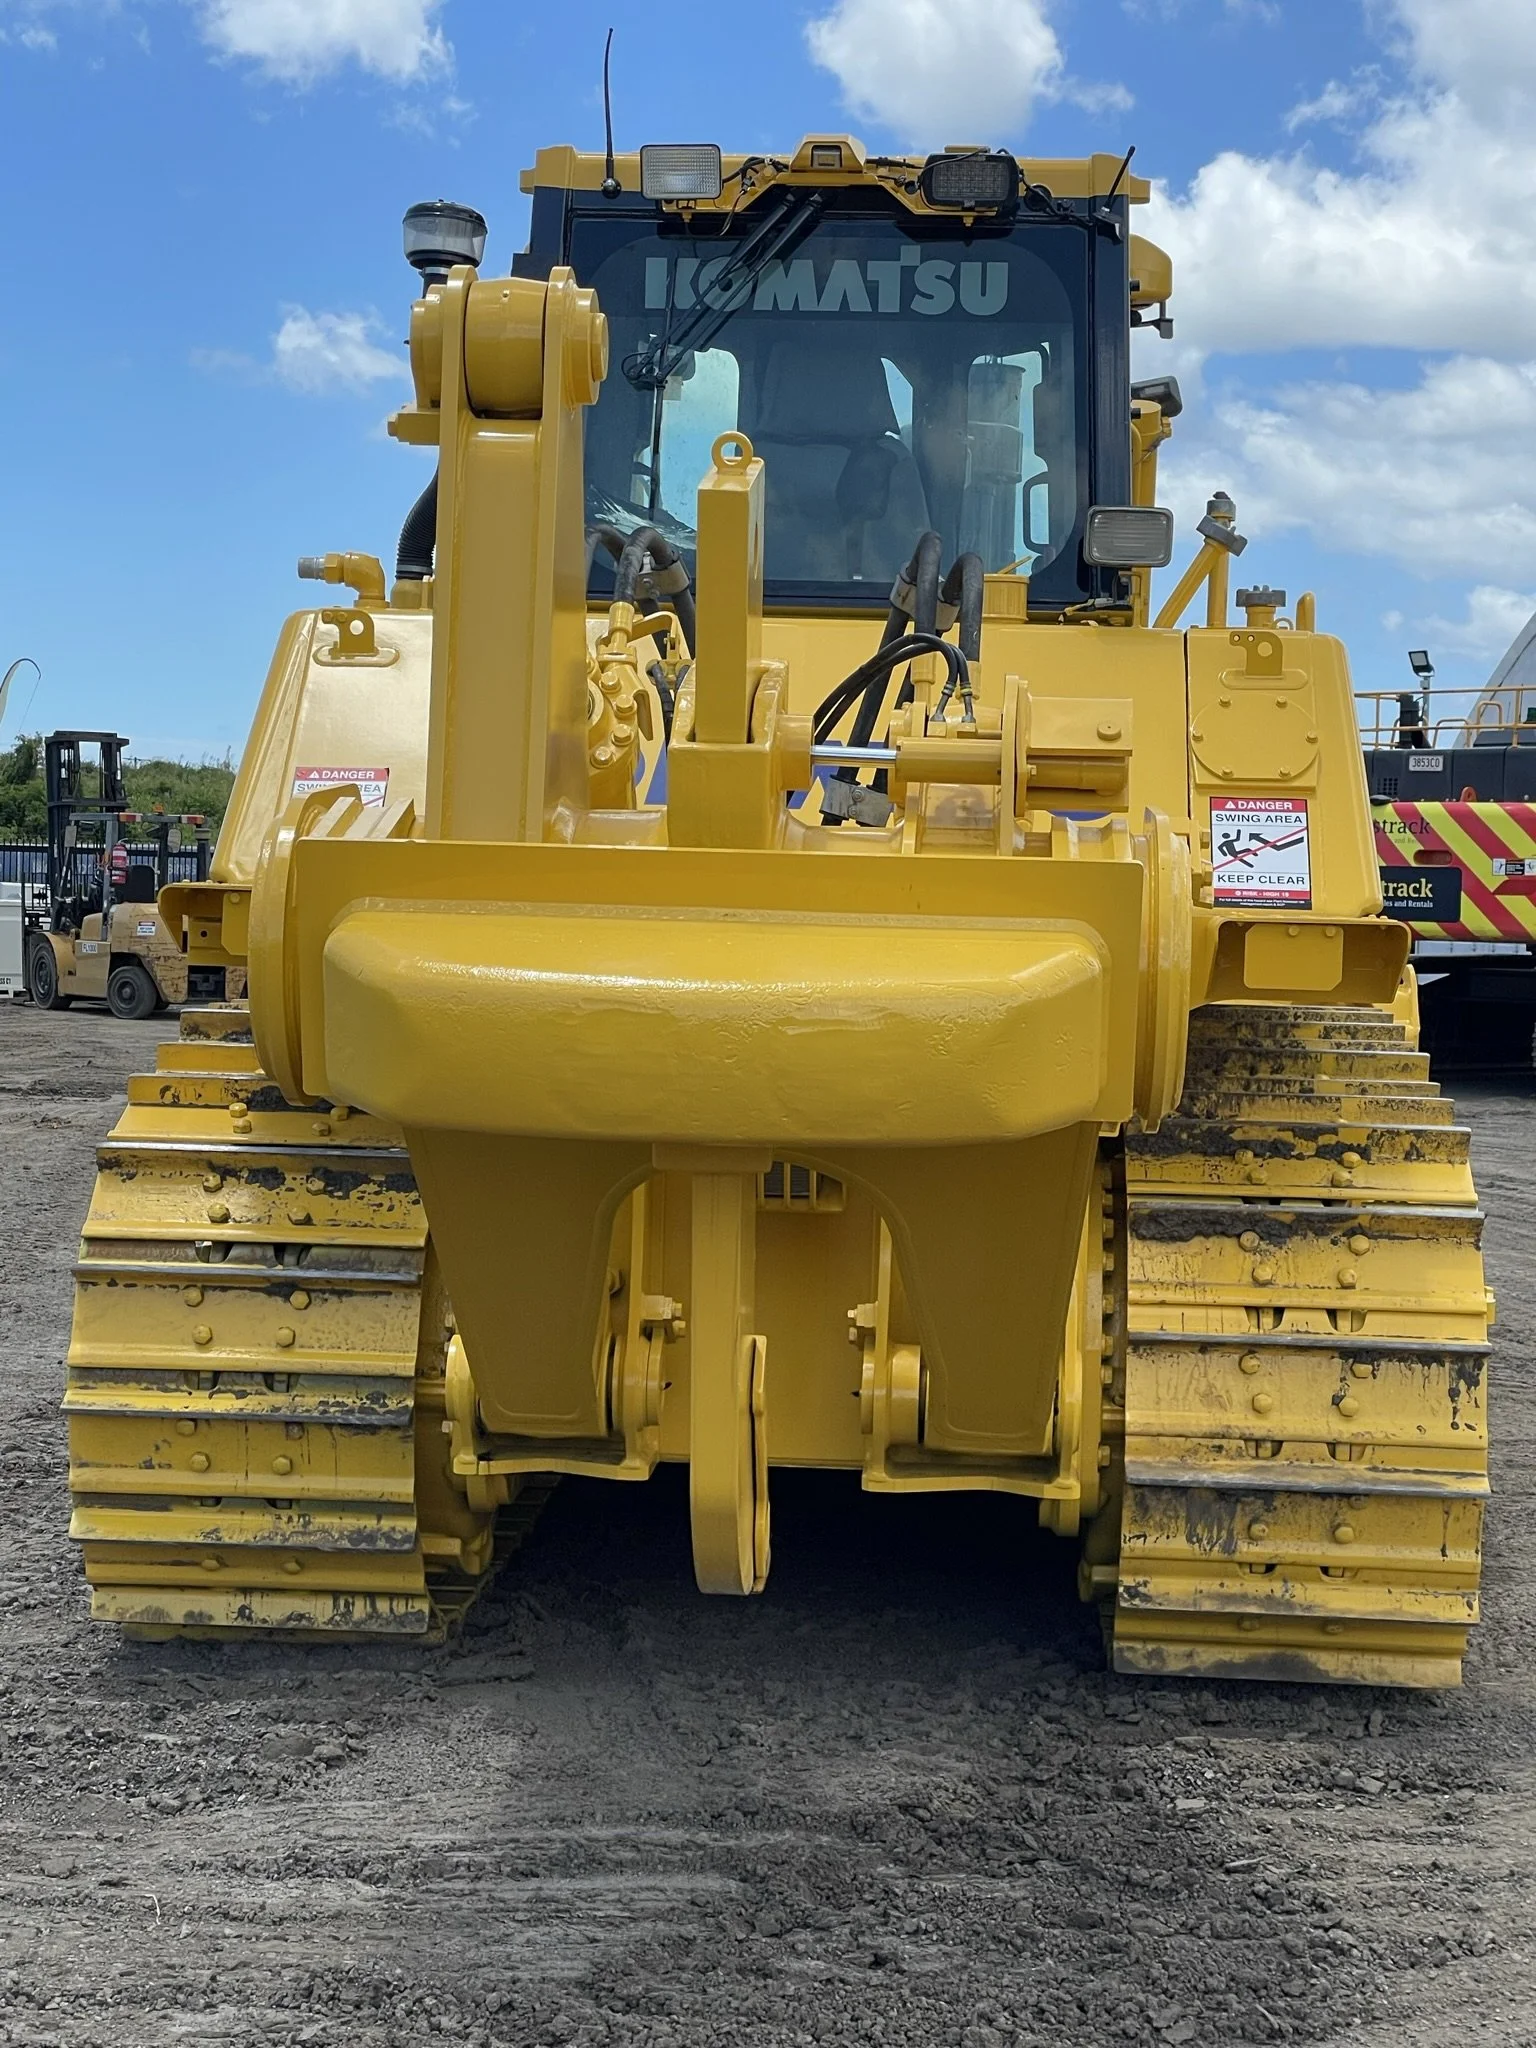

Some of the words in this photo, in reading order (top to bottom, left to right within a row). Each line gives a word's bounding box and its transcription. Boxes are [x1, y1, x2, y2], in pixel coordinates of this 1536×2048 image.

[645, 245, 1009, 316] KOMATSU
[322, 771, 375, 779] DANGER
[1238, 801, 1293, 810] DANGER
[1215, 813, 1260, 822] SWING
[1265, 815, 1303, 824] AREA
[1217, 874, 1254, 883] KEEP
[1258, 875, 1305, 885] CLEAR
[1408, 900, 1433, 908] Rentals
